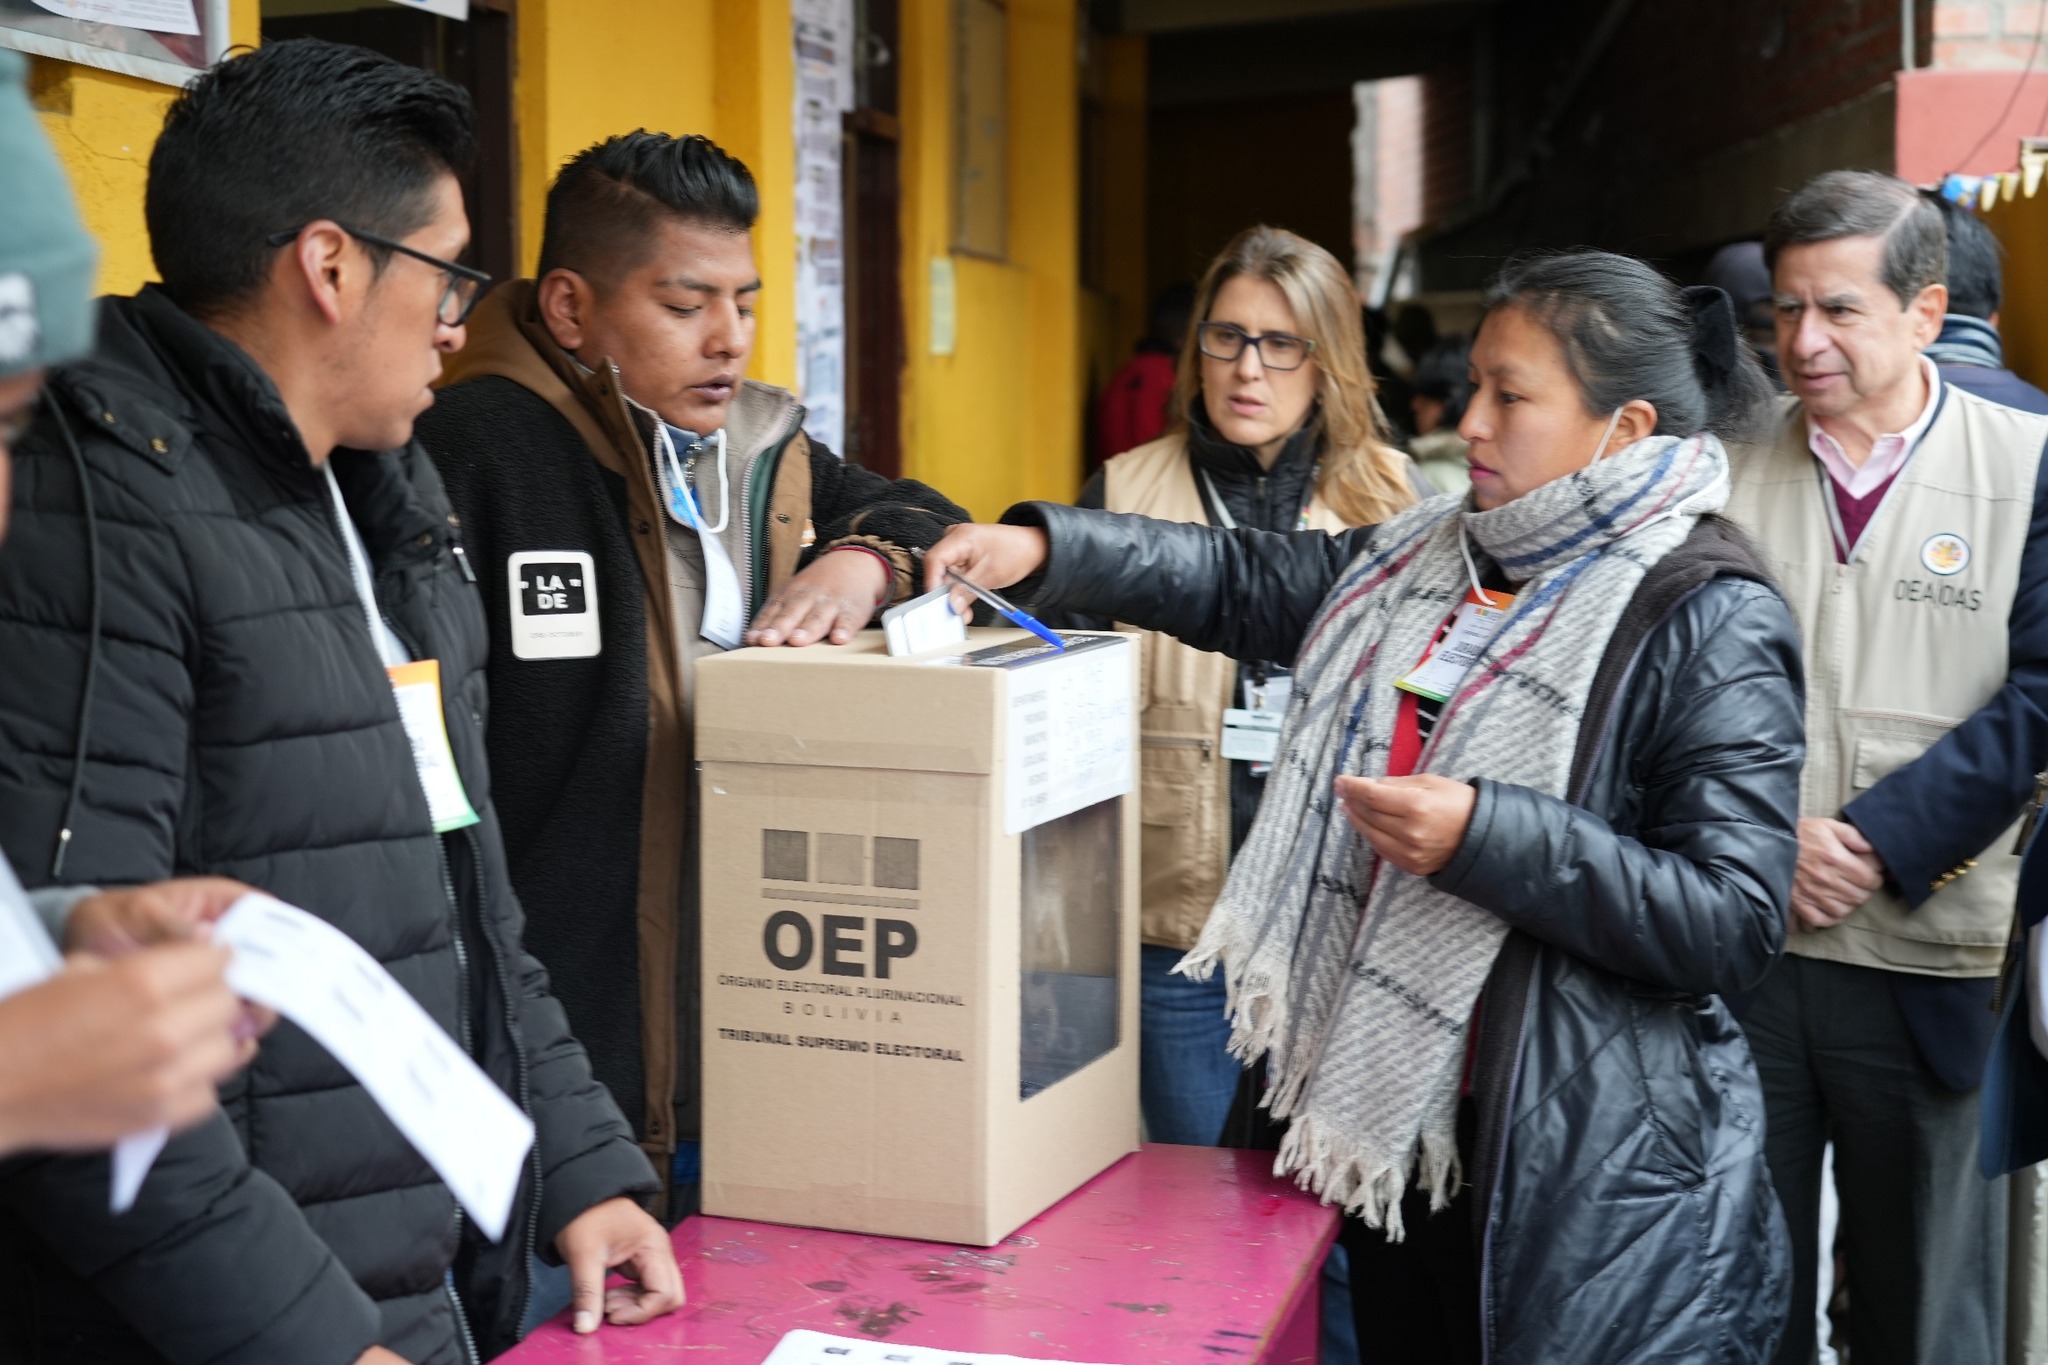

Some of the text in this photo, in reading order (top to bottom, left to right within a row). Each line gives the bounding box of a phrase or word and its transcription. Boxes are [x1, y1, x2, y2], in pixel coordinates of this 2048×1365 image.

[536, 575, 566, 591] LA
[537, 593, 569, 609] DE
[763, 910, 918, 979] OEP
[777, 980, 853, 997] ELECTORAL
[857, 986, 966, 1006] PLURINACIONAL
[783, 1002, 903, 1023] BOLIVIA
[718, 1027, 964, 1062] TRIBUNAL SUPREMO ELECTORAL
